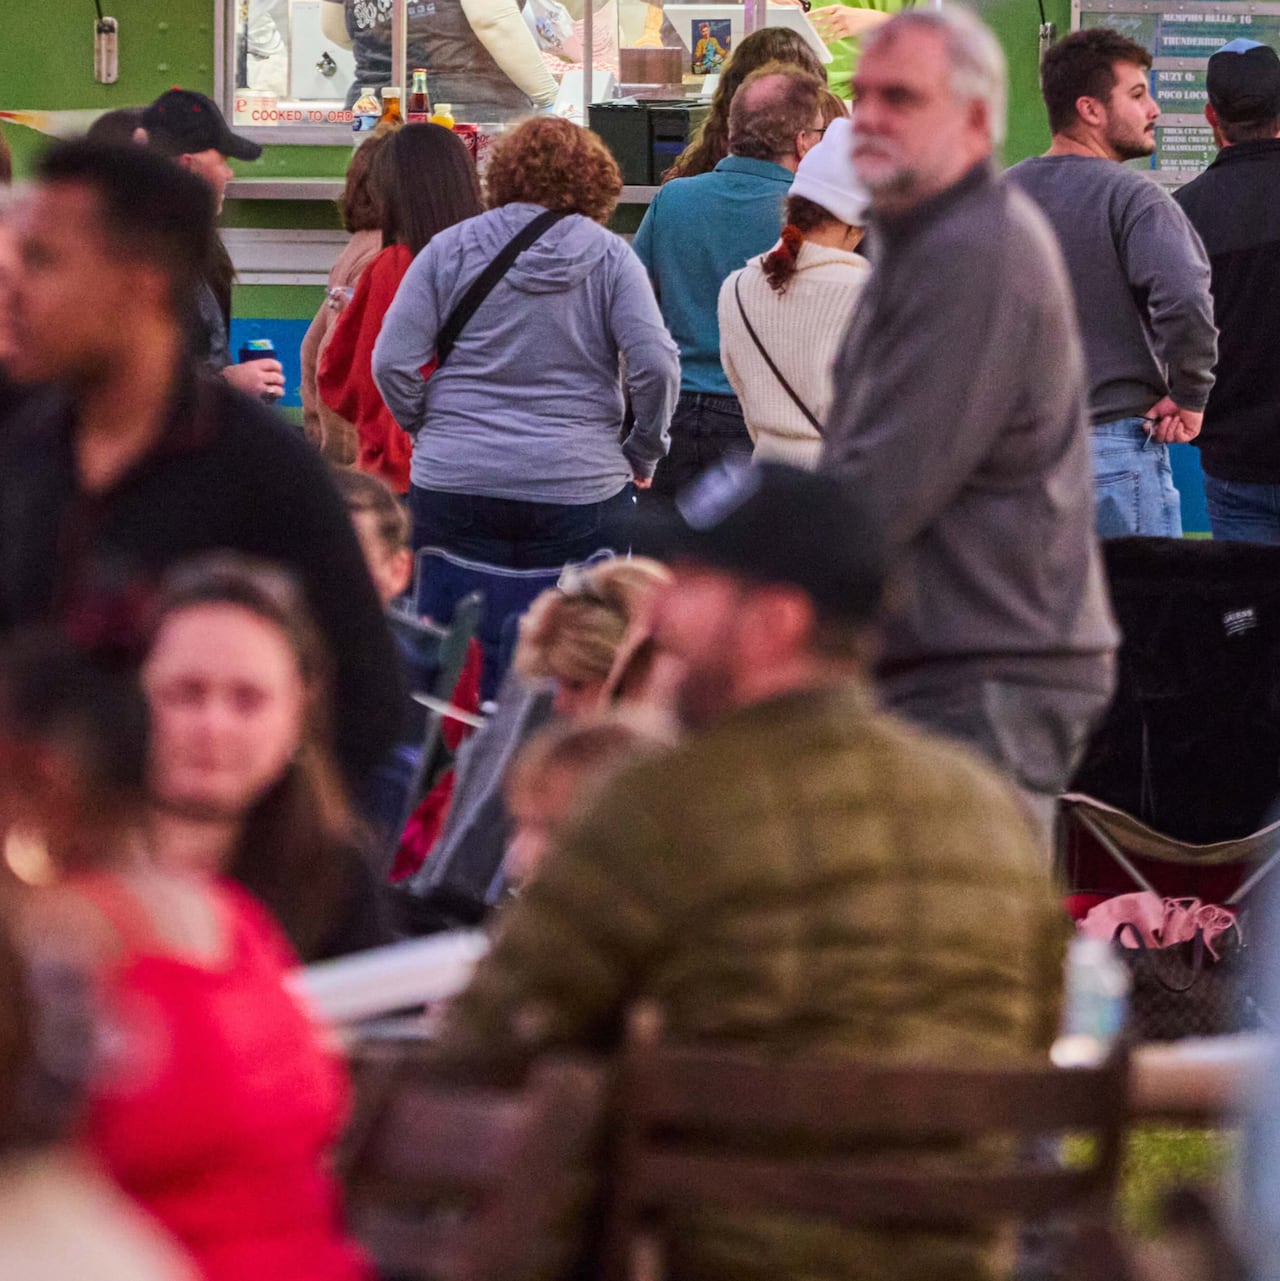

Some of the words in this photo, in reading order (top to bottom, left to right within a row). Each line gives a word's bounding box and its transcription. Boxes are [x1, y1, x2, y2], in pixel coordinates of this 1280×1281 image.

[1158, 72, 1183, 82] SUZY
[1157, 90, 1183, 100] POCO
[252, 110, 303, 122] COOKED
[307, 110, 322, 122] TO
[327, 110, 354, 122] ORD
